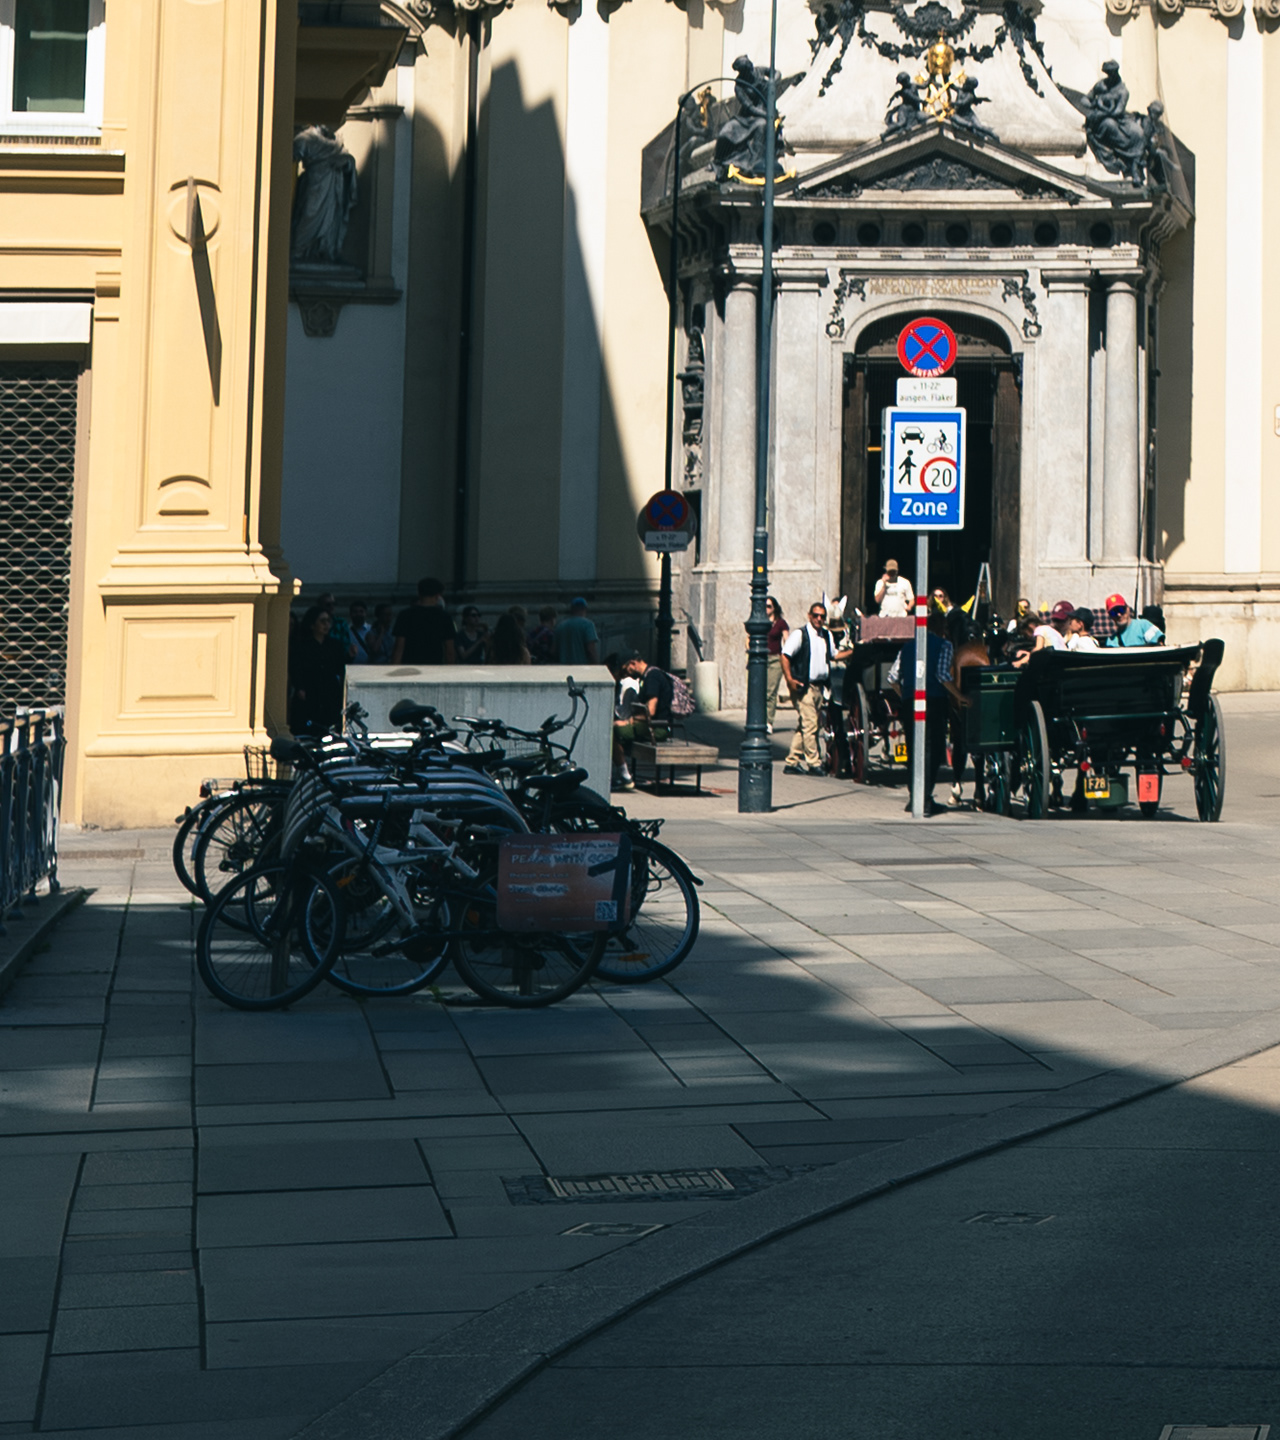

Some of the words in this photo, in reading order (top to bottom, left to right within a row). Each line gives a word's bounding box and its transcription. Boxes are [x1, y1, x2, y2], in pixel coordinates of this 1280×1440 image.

[911, 366, 945, 378] ANFANG
[931, 468, 952, 488] 20
[901, 498, 948, 516] Zone
